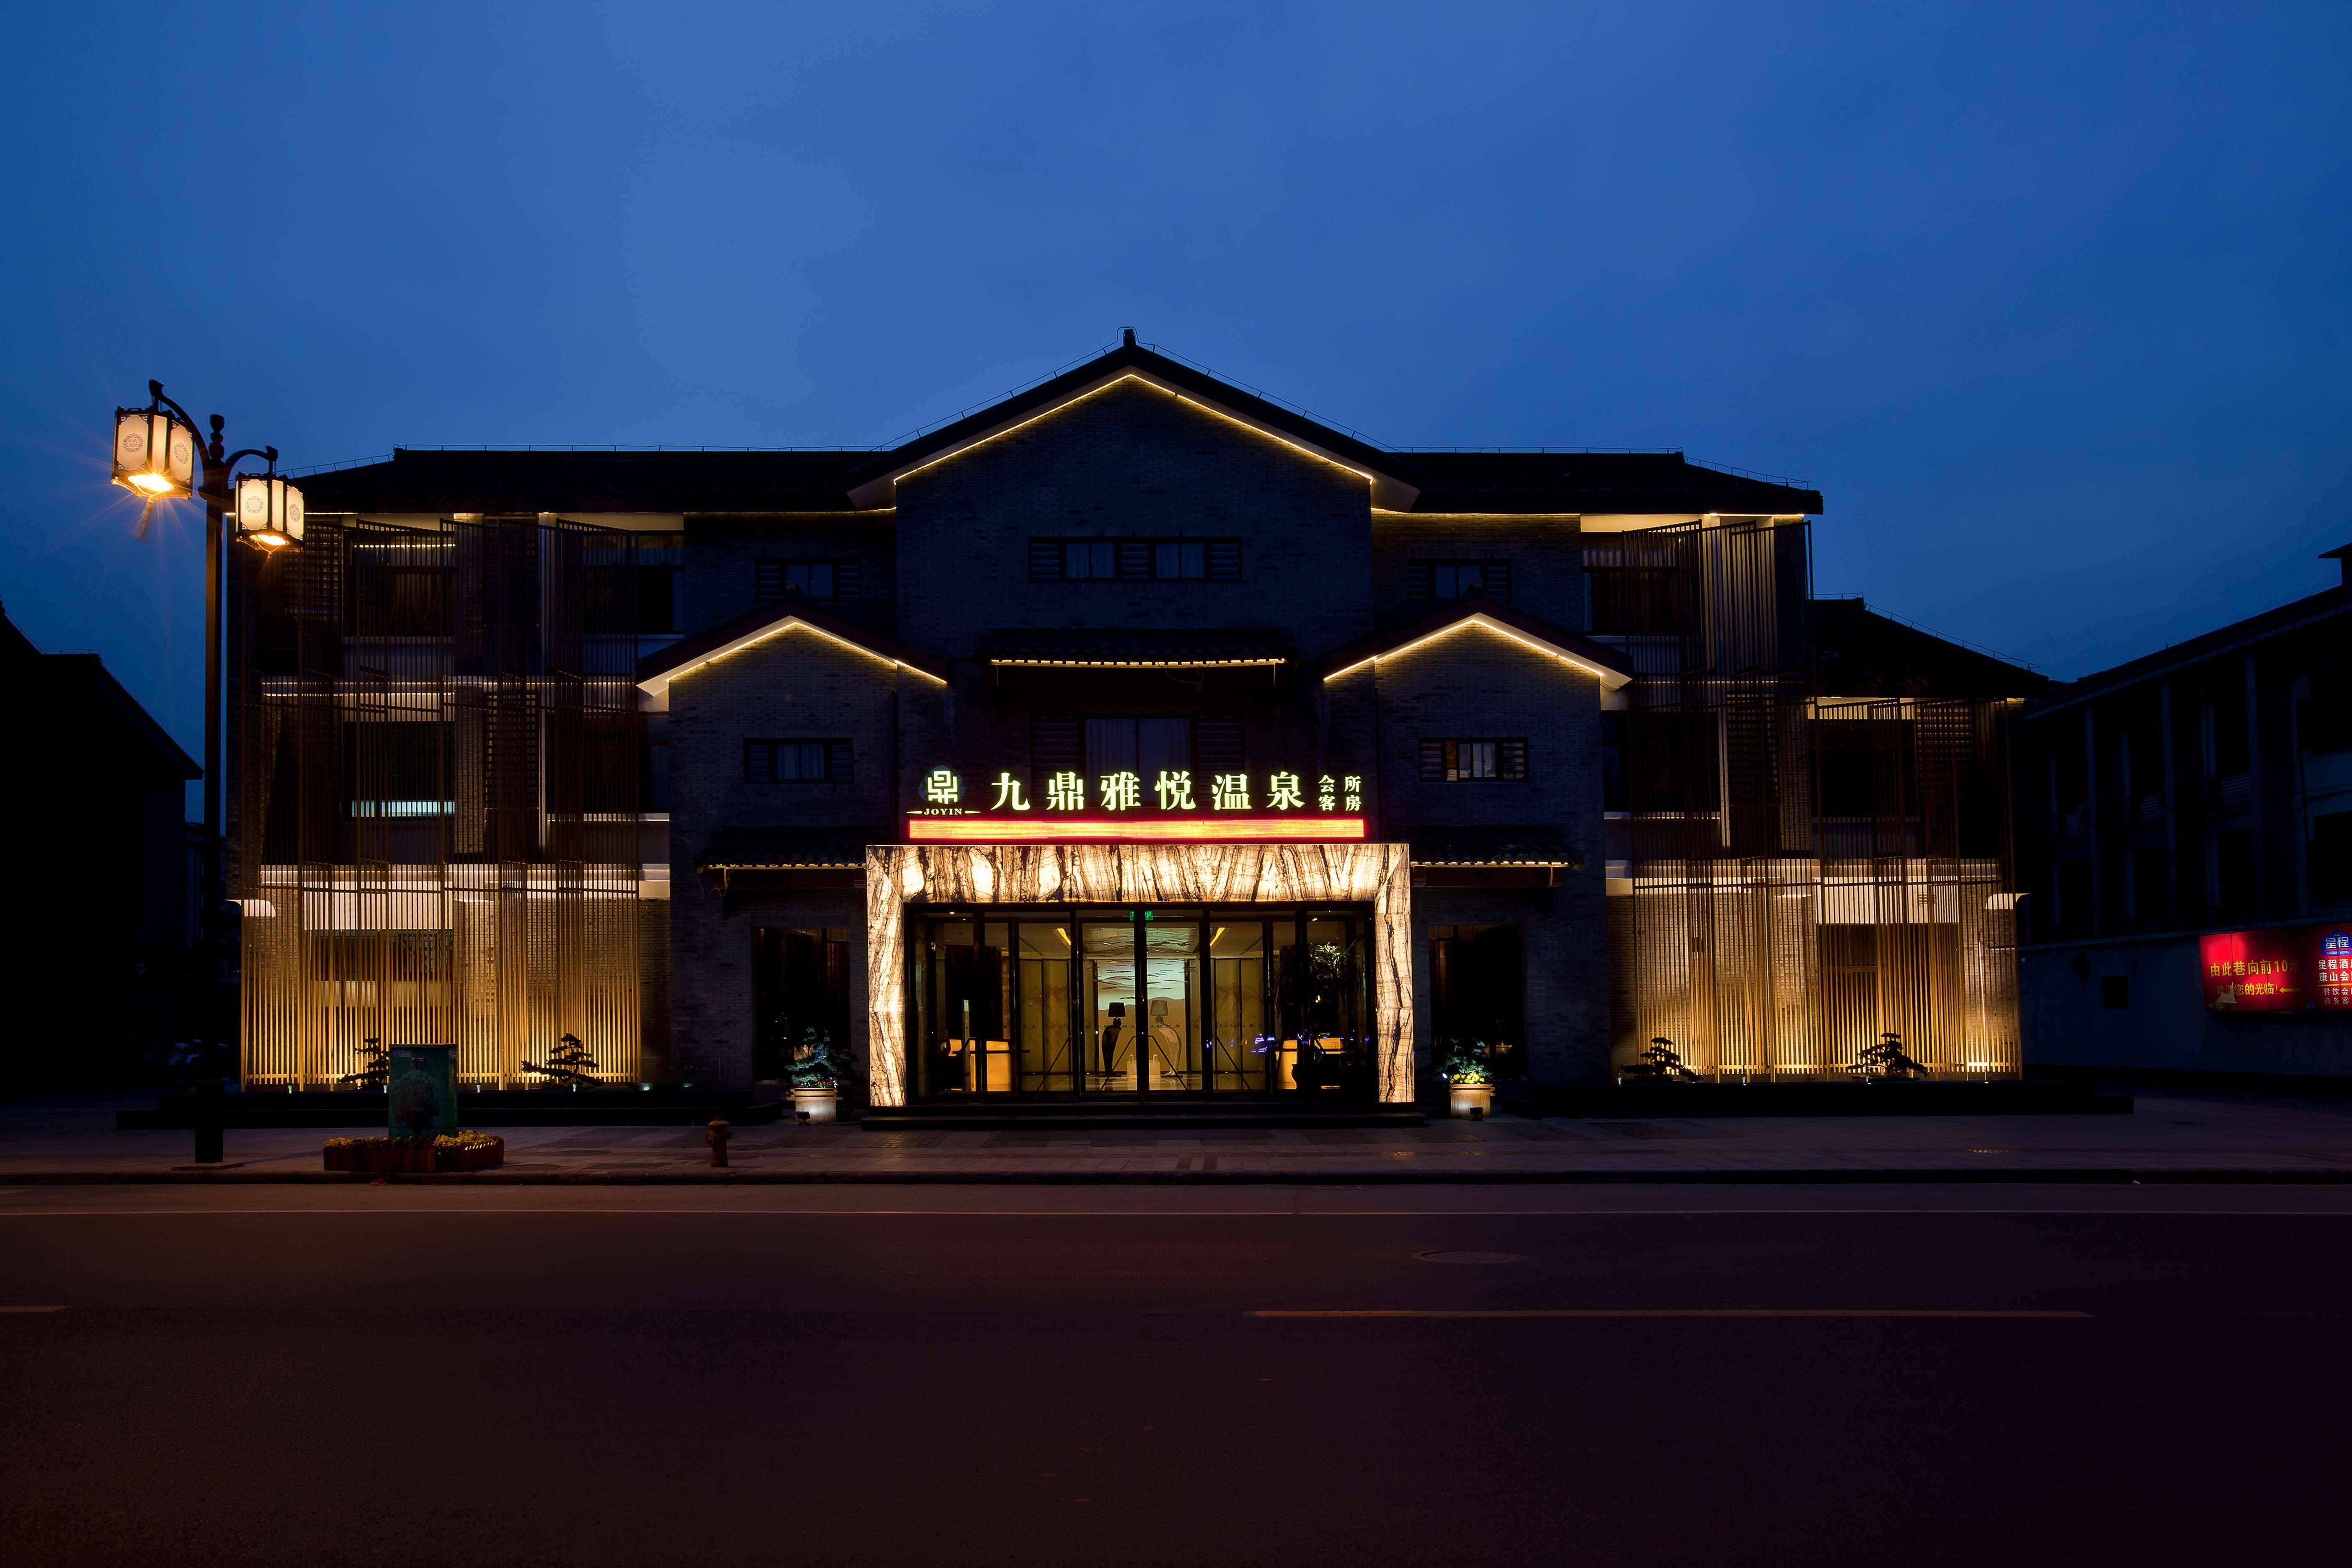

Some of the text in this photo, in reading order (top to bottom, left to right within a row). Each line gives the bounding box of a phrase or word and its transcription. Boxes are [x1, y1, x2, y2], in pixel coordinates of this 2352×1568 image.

[990, 771, 1305, 811] 九鼎雅悦温泉
[2326, 936, 2349, 949] 星程
[2318, 959, 2352, 970] 星程酒
[2319, 971, 2352, 982] 康山会
[2323, 987, 2352, 996] 餐饮会
[2324, 997, 2352, 1005] 商务客
